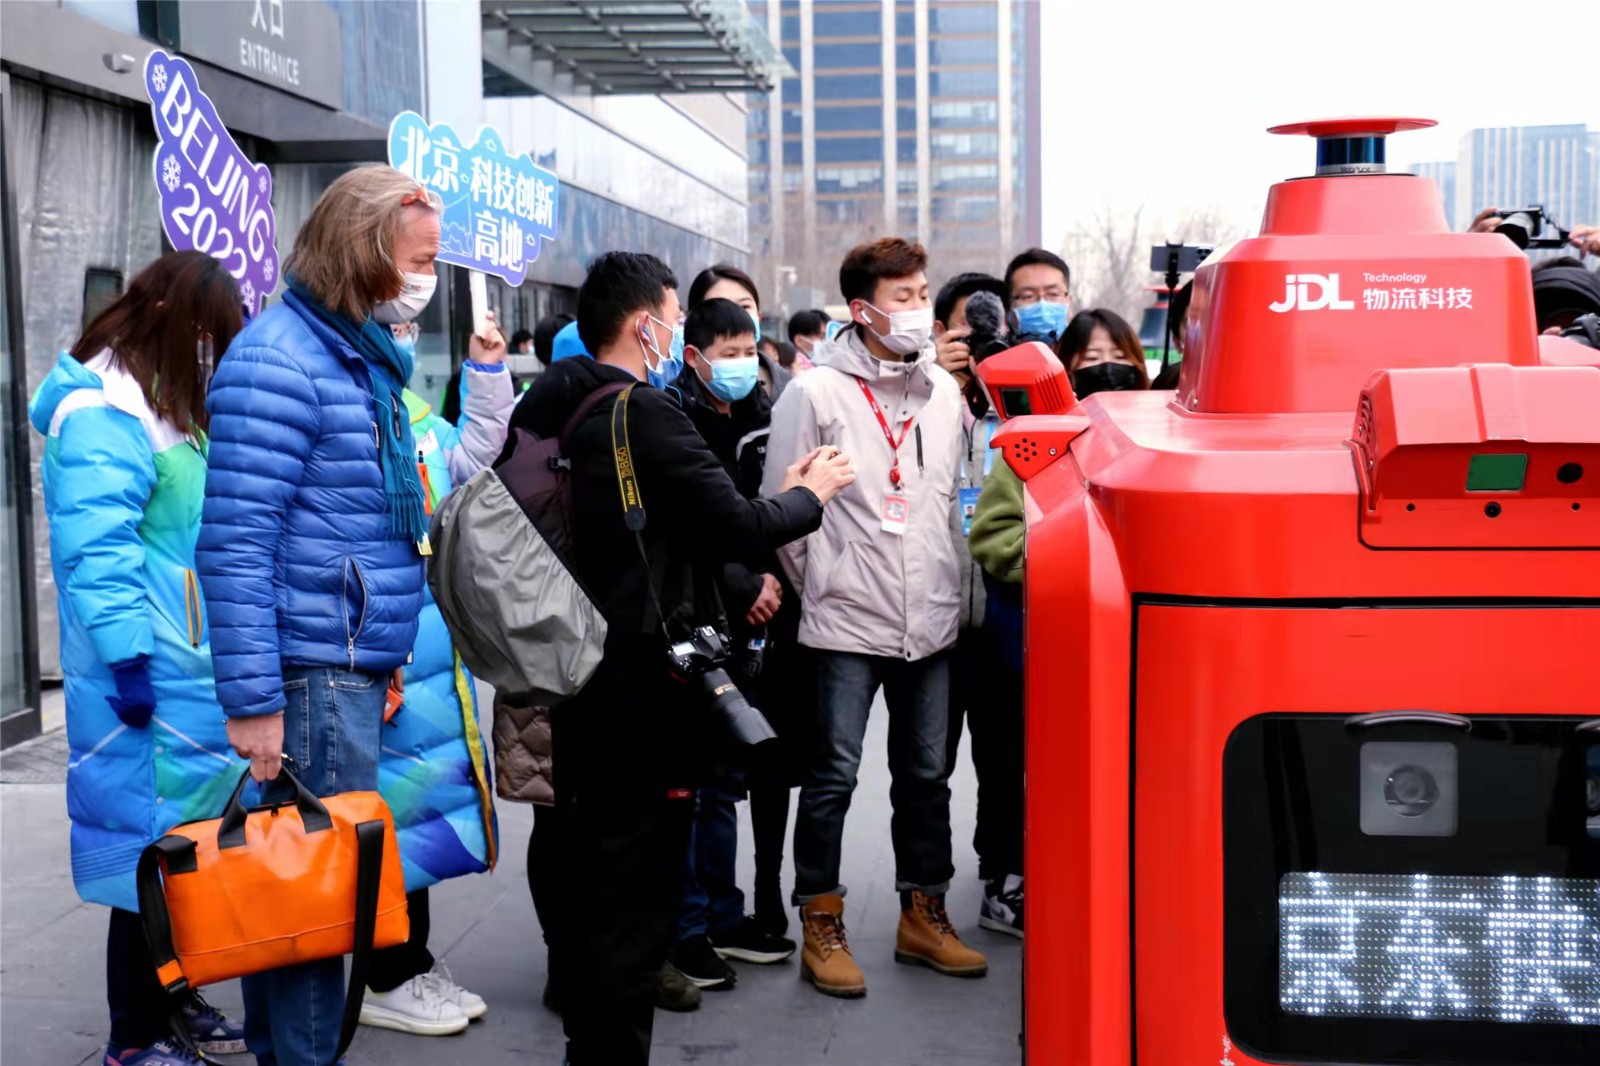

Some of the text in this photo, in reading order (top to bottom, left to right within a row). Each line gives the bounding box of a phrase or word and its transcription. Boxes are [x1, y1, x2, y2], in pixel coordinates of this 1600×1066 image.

[251, 0, 284, 39] 入口
[240, 38, 299, 85] ENTRANCE
[161, 71, 269, 262] BEIJING
[400, 125, 554, 228] 北京 科技创新
[475, 211, 523, 272] 高地
[1363, 272, 1427, 284] Technology
[1363, 287, 1473, 310] 物流科技
[617, 446, 636, 505] Nikon D850
[1279, 871, 1600, 1022] 京东快
